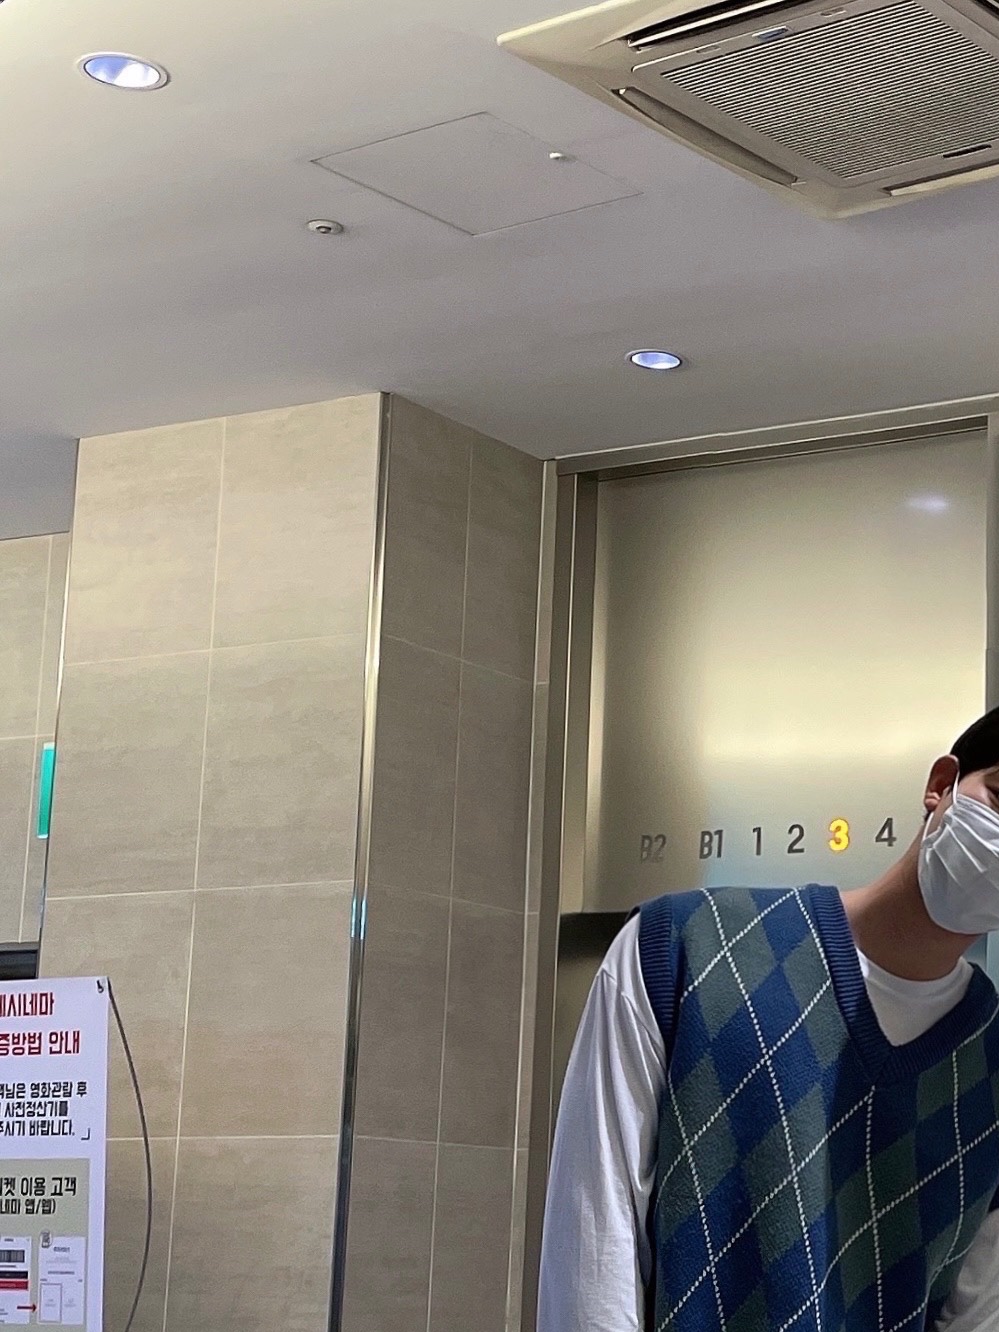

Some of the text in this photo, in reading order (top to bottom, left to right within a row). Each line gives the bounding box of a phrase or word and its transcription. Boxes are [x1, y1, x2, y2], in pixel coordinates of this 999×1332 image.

[699, 829, 724, 859] B1
[752, 826, 763, 856] 1
[787, 824, 806, 854] 2
[828, 817, 850, 851] 3
[874, 817, 898, 847] 4
[49, 1030, 81, 1055] 안내
[30, 1081, 73, 1098] 영화관람
[76, 1081, 88, 1098] 후
[29, 1119, 75, 1136] 바랍니다.
[20, 1177, 46, 1197] 이용
[50, 1177, 77, 1197] 고객
